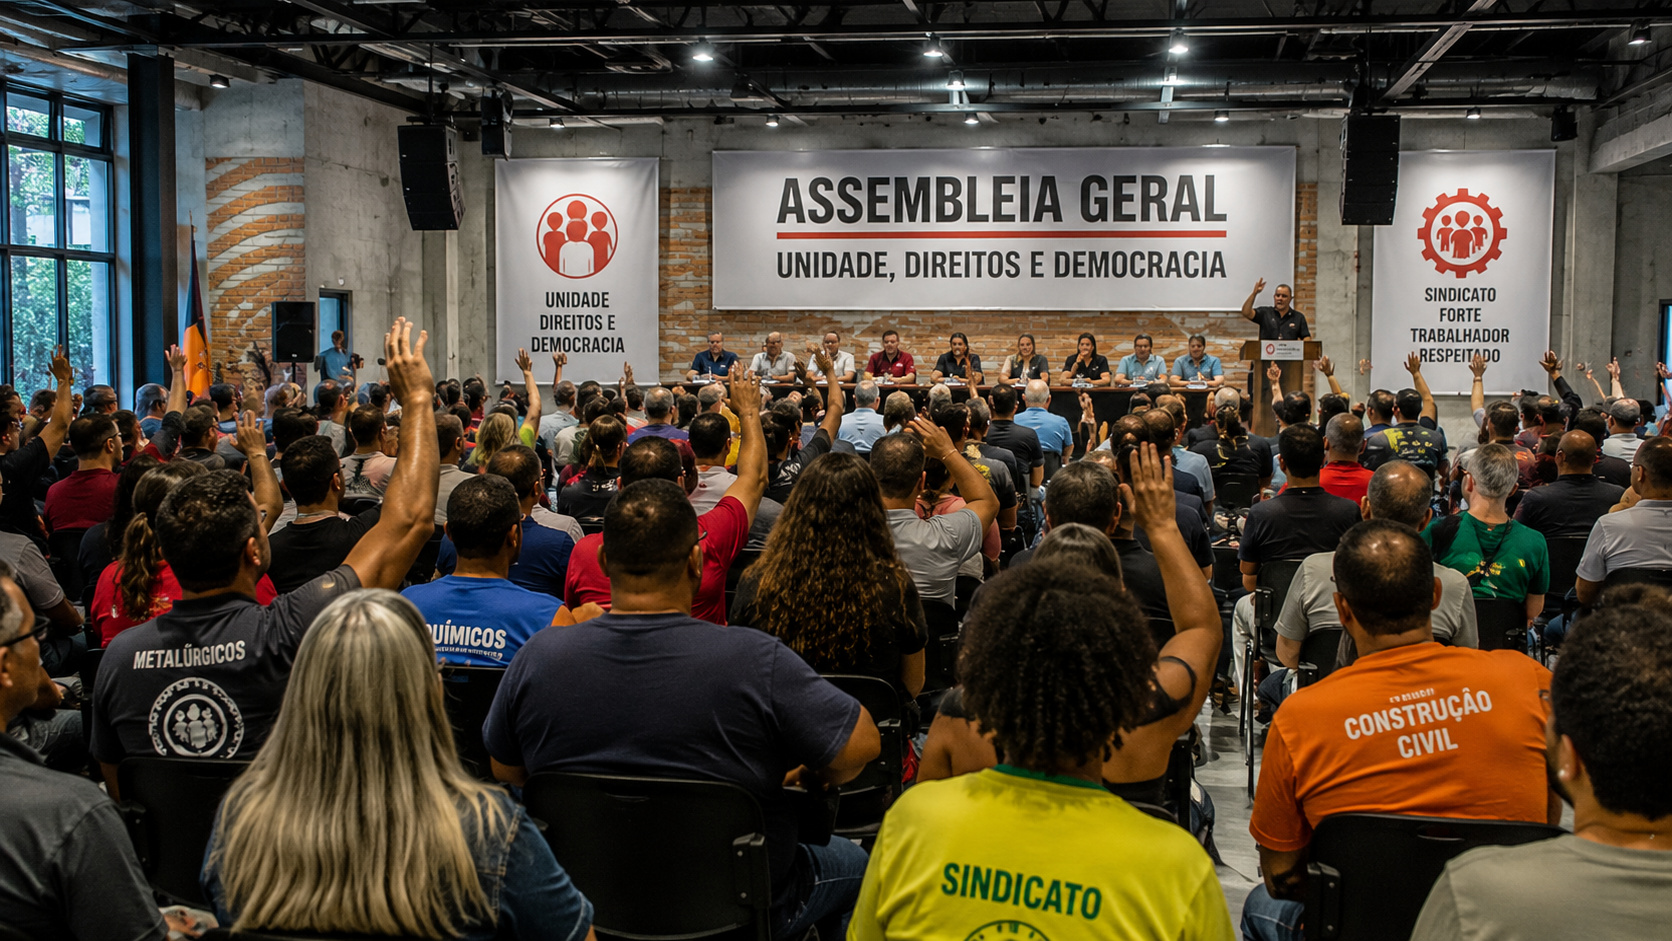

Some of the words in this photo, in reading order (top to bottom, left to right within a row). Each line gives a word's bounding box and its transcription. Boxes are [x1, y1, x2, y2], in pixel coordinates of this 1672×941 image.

[776, 175, 1063, 224] ASSEMBLEIA
[1080, 174, 1228, 223] GERAL
[777, 251, 895, 283] UNIDADE,
[905, 250, 1021, 279] DIREITOS
[1030, 250, 1045, 278] E
[1054, 250, 1227, 279] DEMOCRACIA
[545, 291, 610, 309] UNIDADE
[1424, 287, 1497, 302] SINDICATO
[539, 314, 603, 331] DIREITOS
[607, 314, 616, 331] E
[1439, 307, 1482, 323] FORTE
[1410, 328, 1510, 343] TRABALHADOR
[531, 336, 625, 353] DEMOCRACIA
[1397, 727, 1459, 759] CIVIL
[940, 862, 1103, 921] SINDICATO
